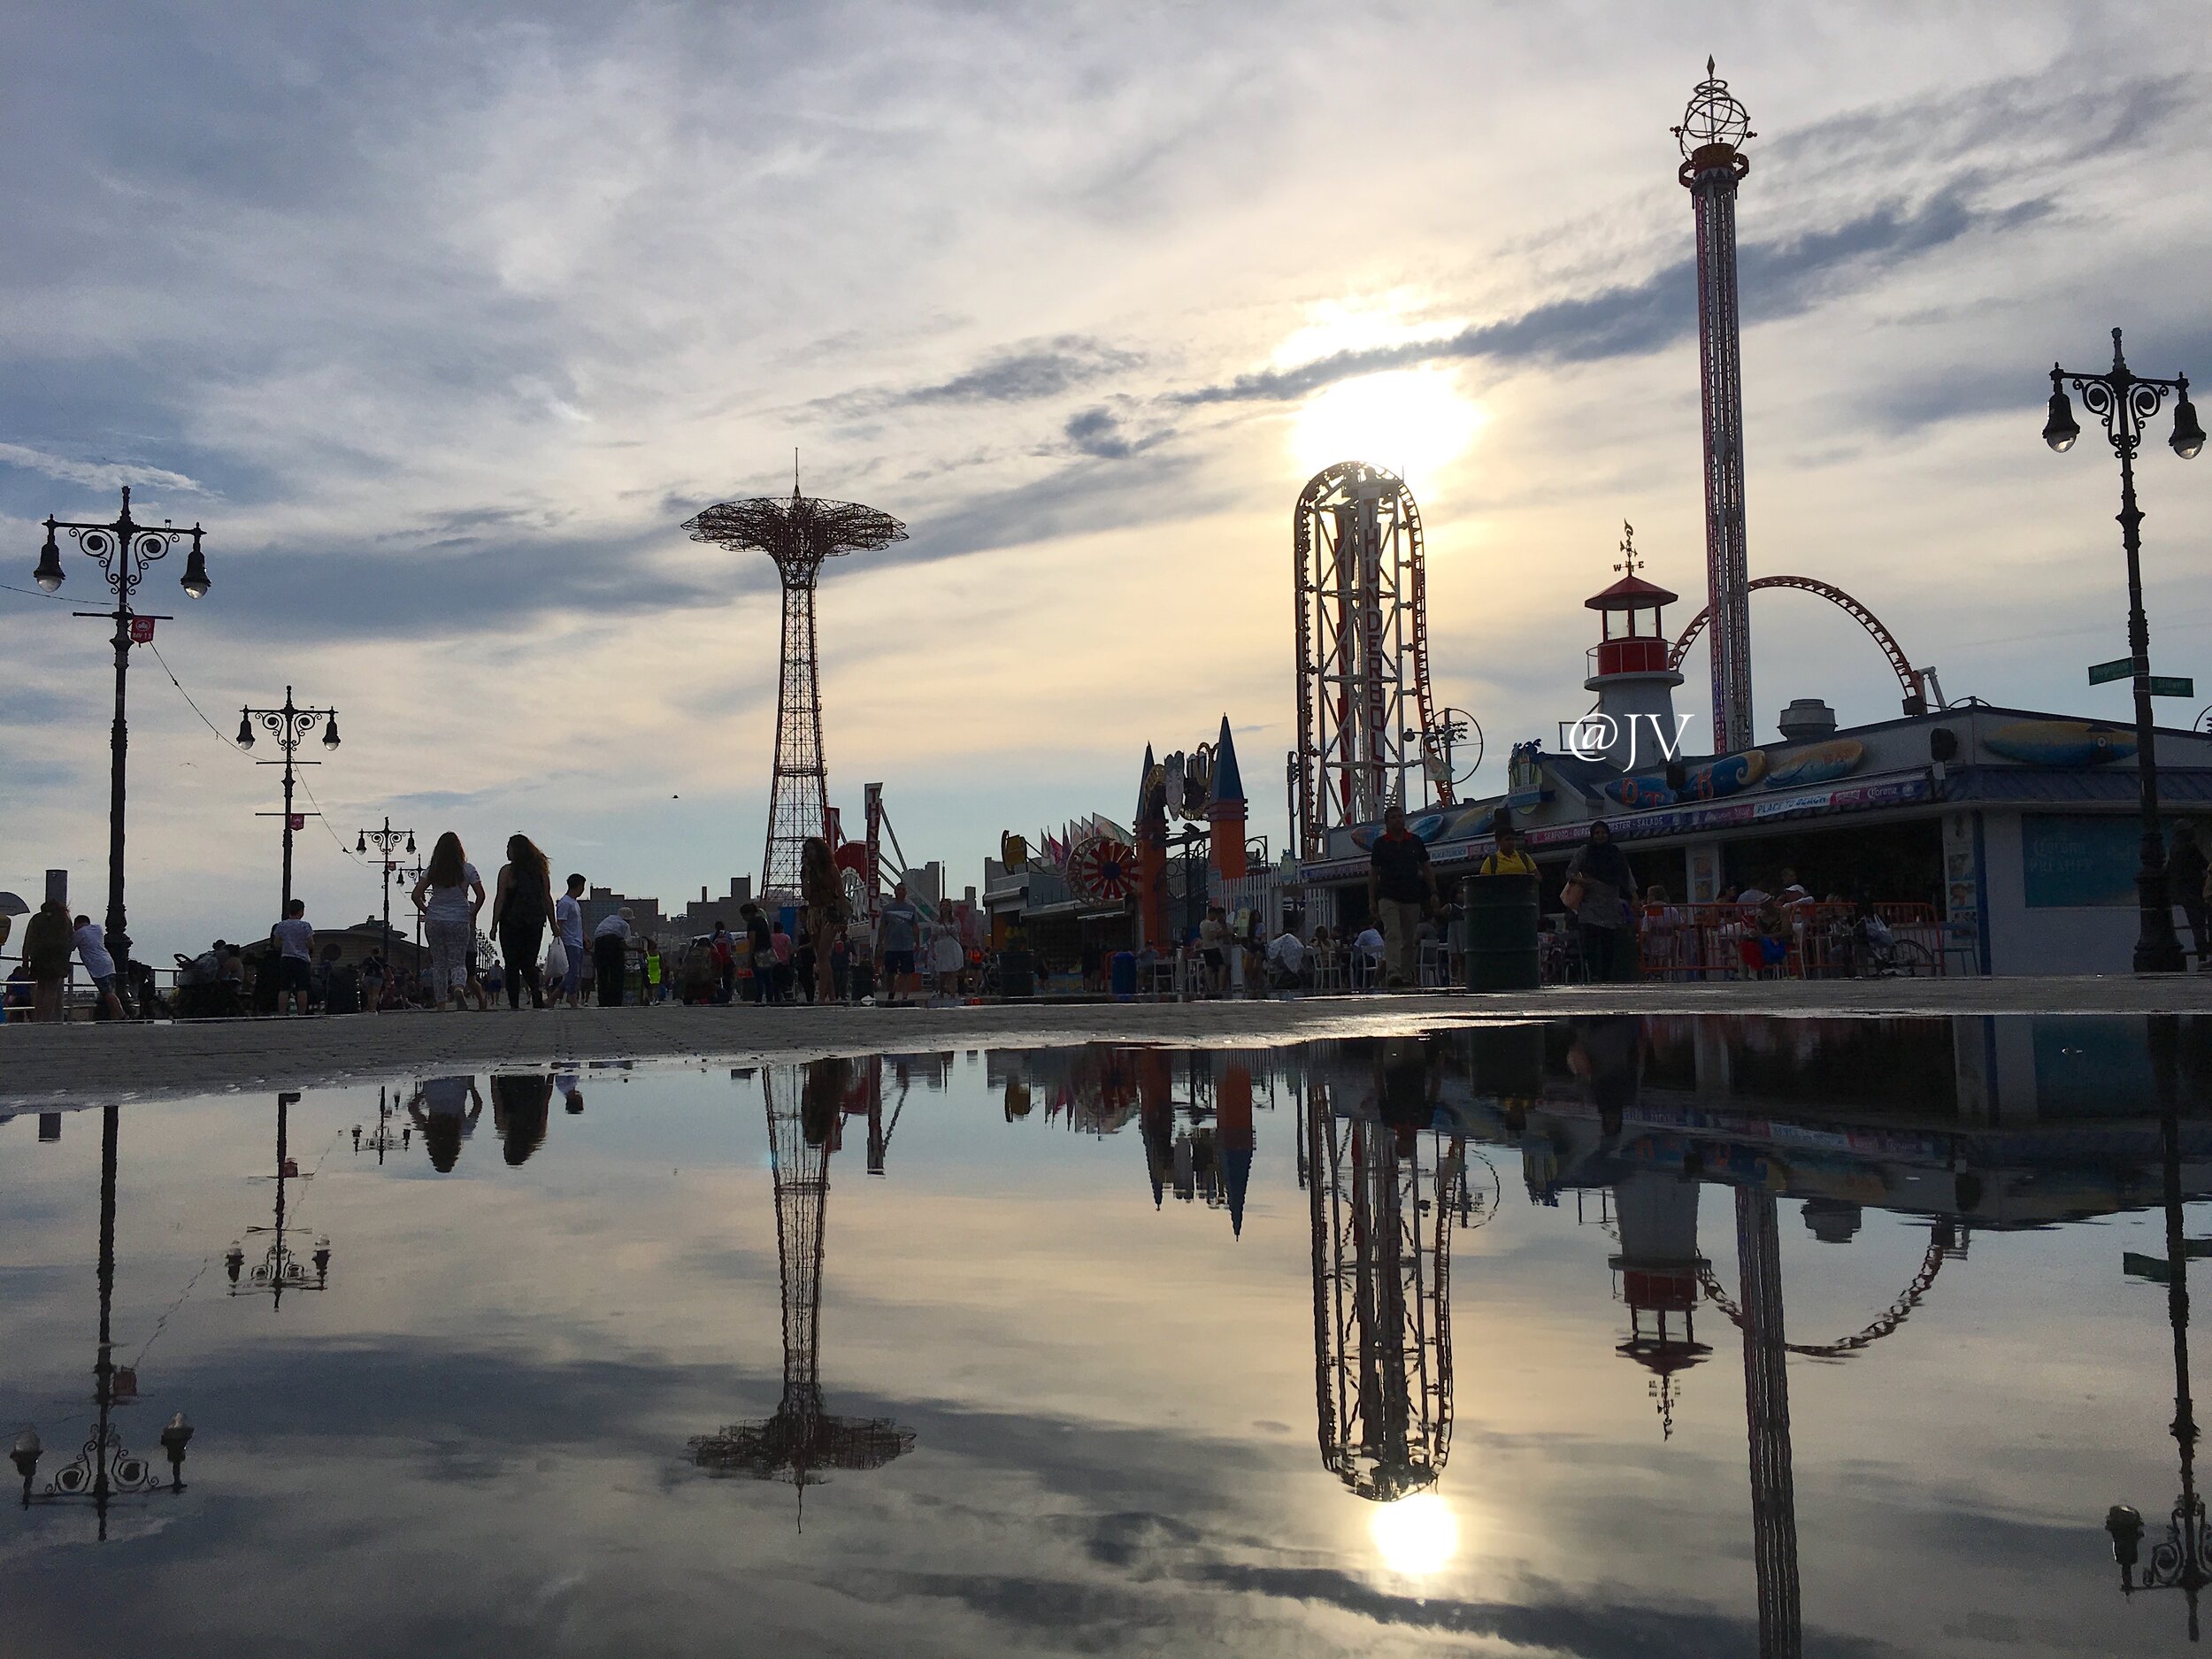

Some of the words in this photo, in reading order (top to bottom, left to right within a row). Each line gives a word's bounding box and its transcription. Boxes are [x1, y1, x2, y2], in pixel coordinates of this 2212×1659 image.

[1363, 497, 1386, 797] THUNDERBOLT
[868, 787, 881, 930] THUNDERBOLT
[1636, 817, 1663, 828] SALADS
